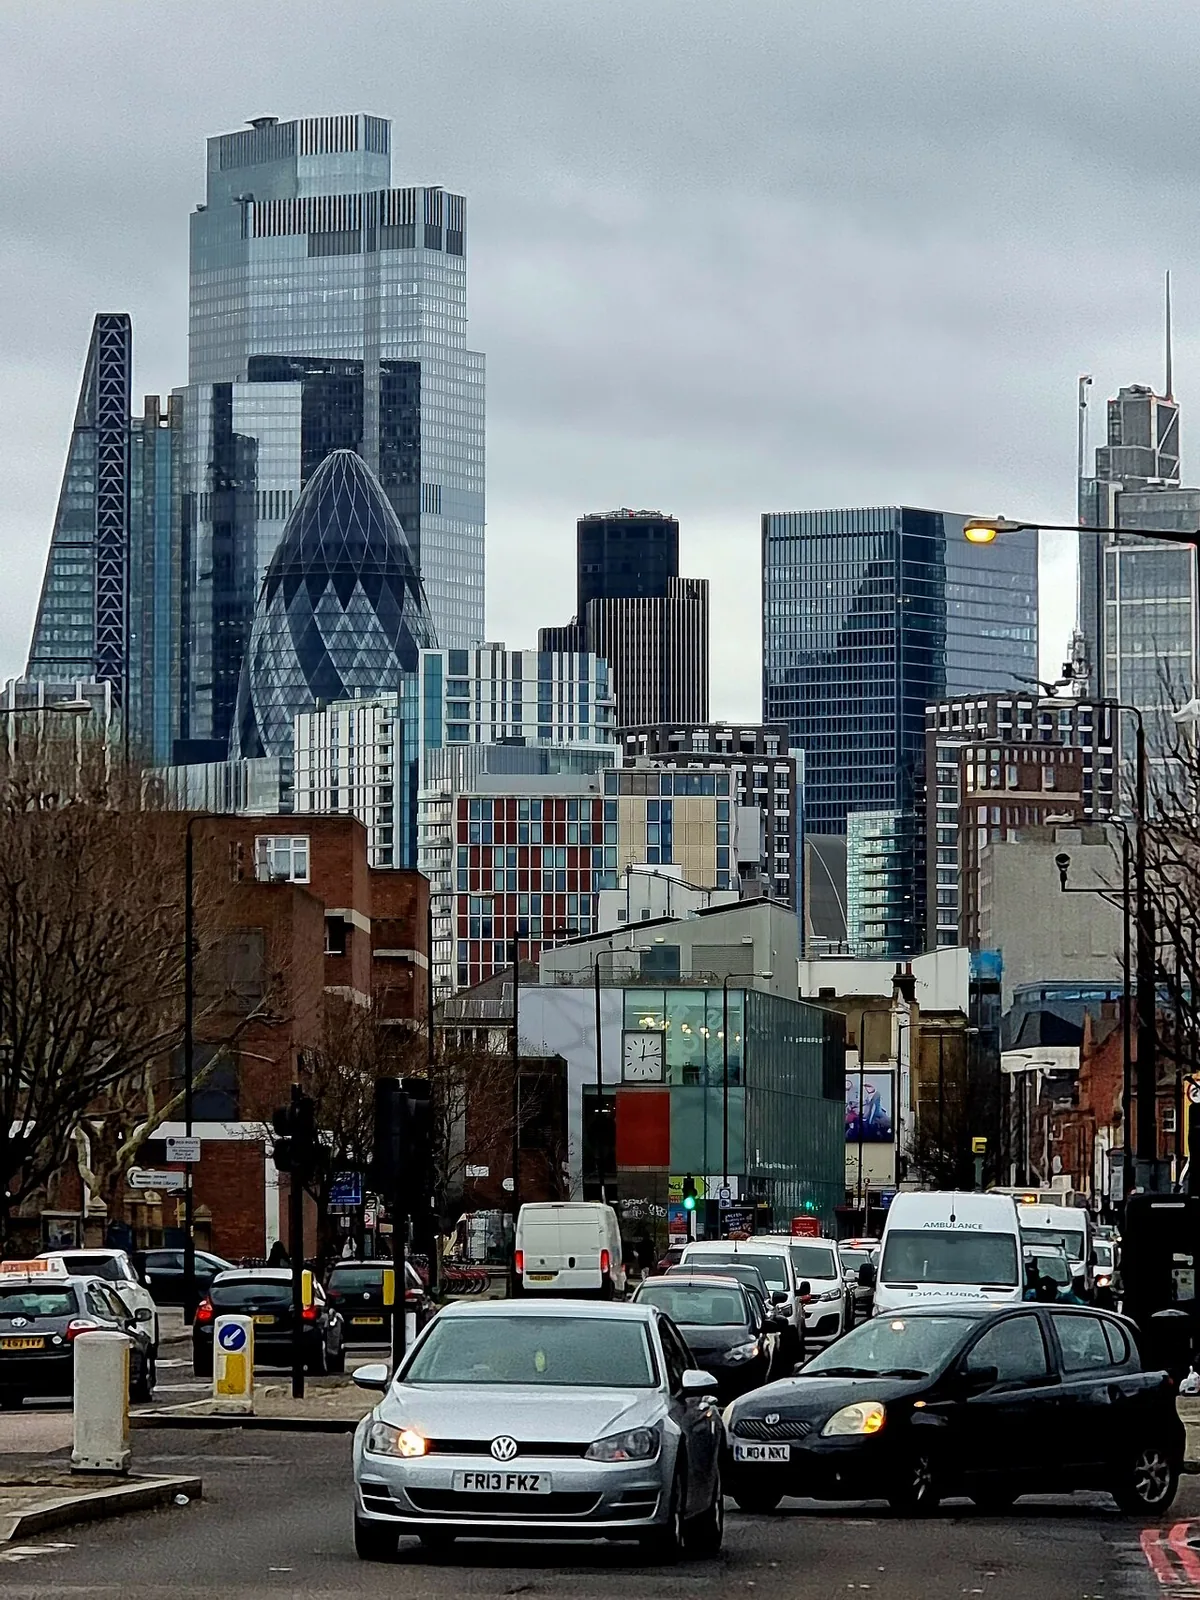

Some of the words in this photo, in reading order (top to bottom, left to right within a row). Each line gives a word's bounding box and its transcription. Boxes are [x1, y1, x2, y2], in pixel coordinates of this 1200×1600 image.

[922, 1222, 984, 1230] AMBULANCE
[463, 1473, 502, 1490] FR13
[505, 1474, 540, 1491] FKZ
